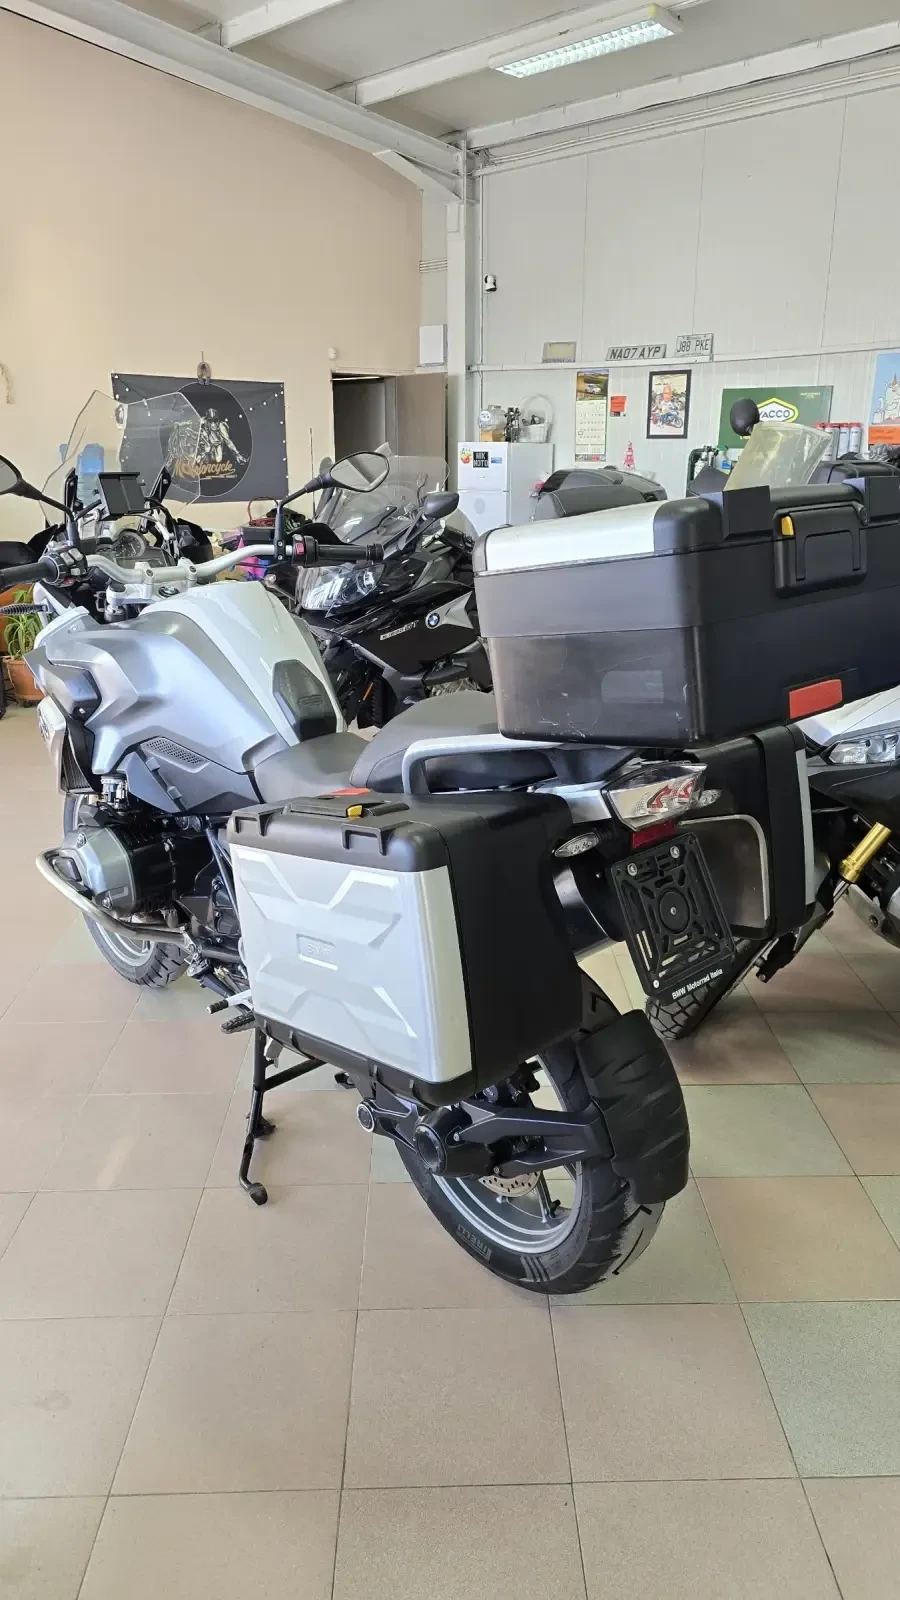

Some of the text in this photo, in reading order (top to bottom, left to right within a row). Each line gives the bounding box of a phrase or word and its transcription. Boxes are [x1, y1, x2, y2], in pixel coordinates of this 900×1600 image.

[638, 346, 661, 359] AYP
[676, 338, 710, 353] J88 PKE
[473, 459, 489, 467] MOTO
[672, 969, 723, 1000] BMW Motorrad Italia
[456, 1223, 493, 1262] PIRELLI
